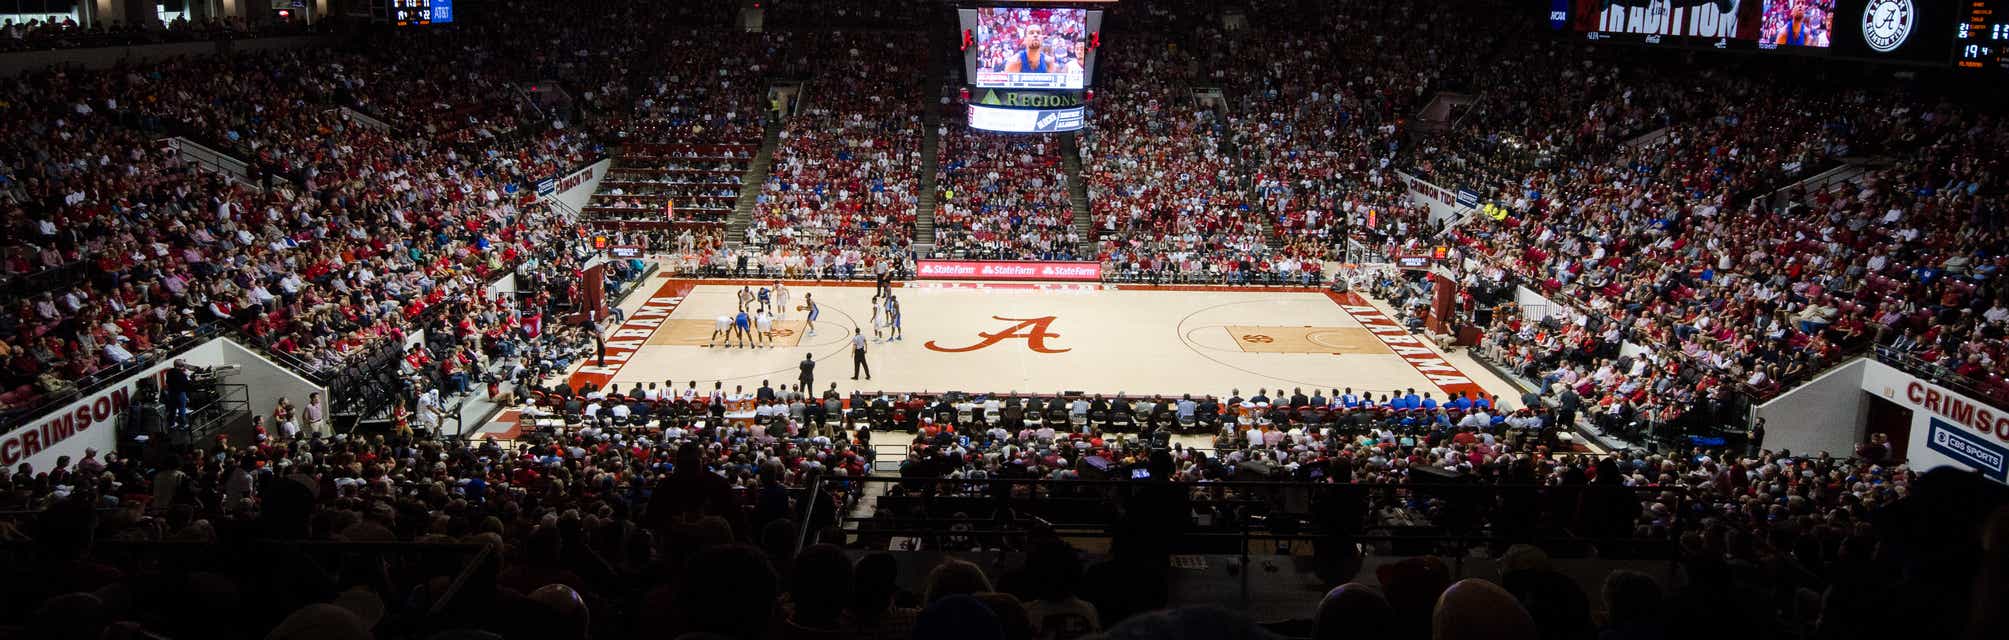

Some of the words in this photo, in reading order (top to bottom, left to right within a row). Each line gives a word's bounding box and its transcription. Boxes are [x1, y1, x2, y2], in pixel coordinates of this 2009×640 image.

[1550, 11, 1566, 20] NCAA
[1964, 44, 1978, 58] 19
[556, 174, 581, 195] CRIMSON
[1409, 178, 1439, 200] CRIMSON
[1440, 190, 1456, 208] TIDE
[1340, 304, 1474, 386] ALABAMA
[0, 385, 130, 467] CRIMSON
[1949, 438, 1966, 451] CBS
[1966, 445, 1999, 465] SPORTS
